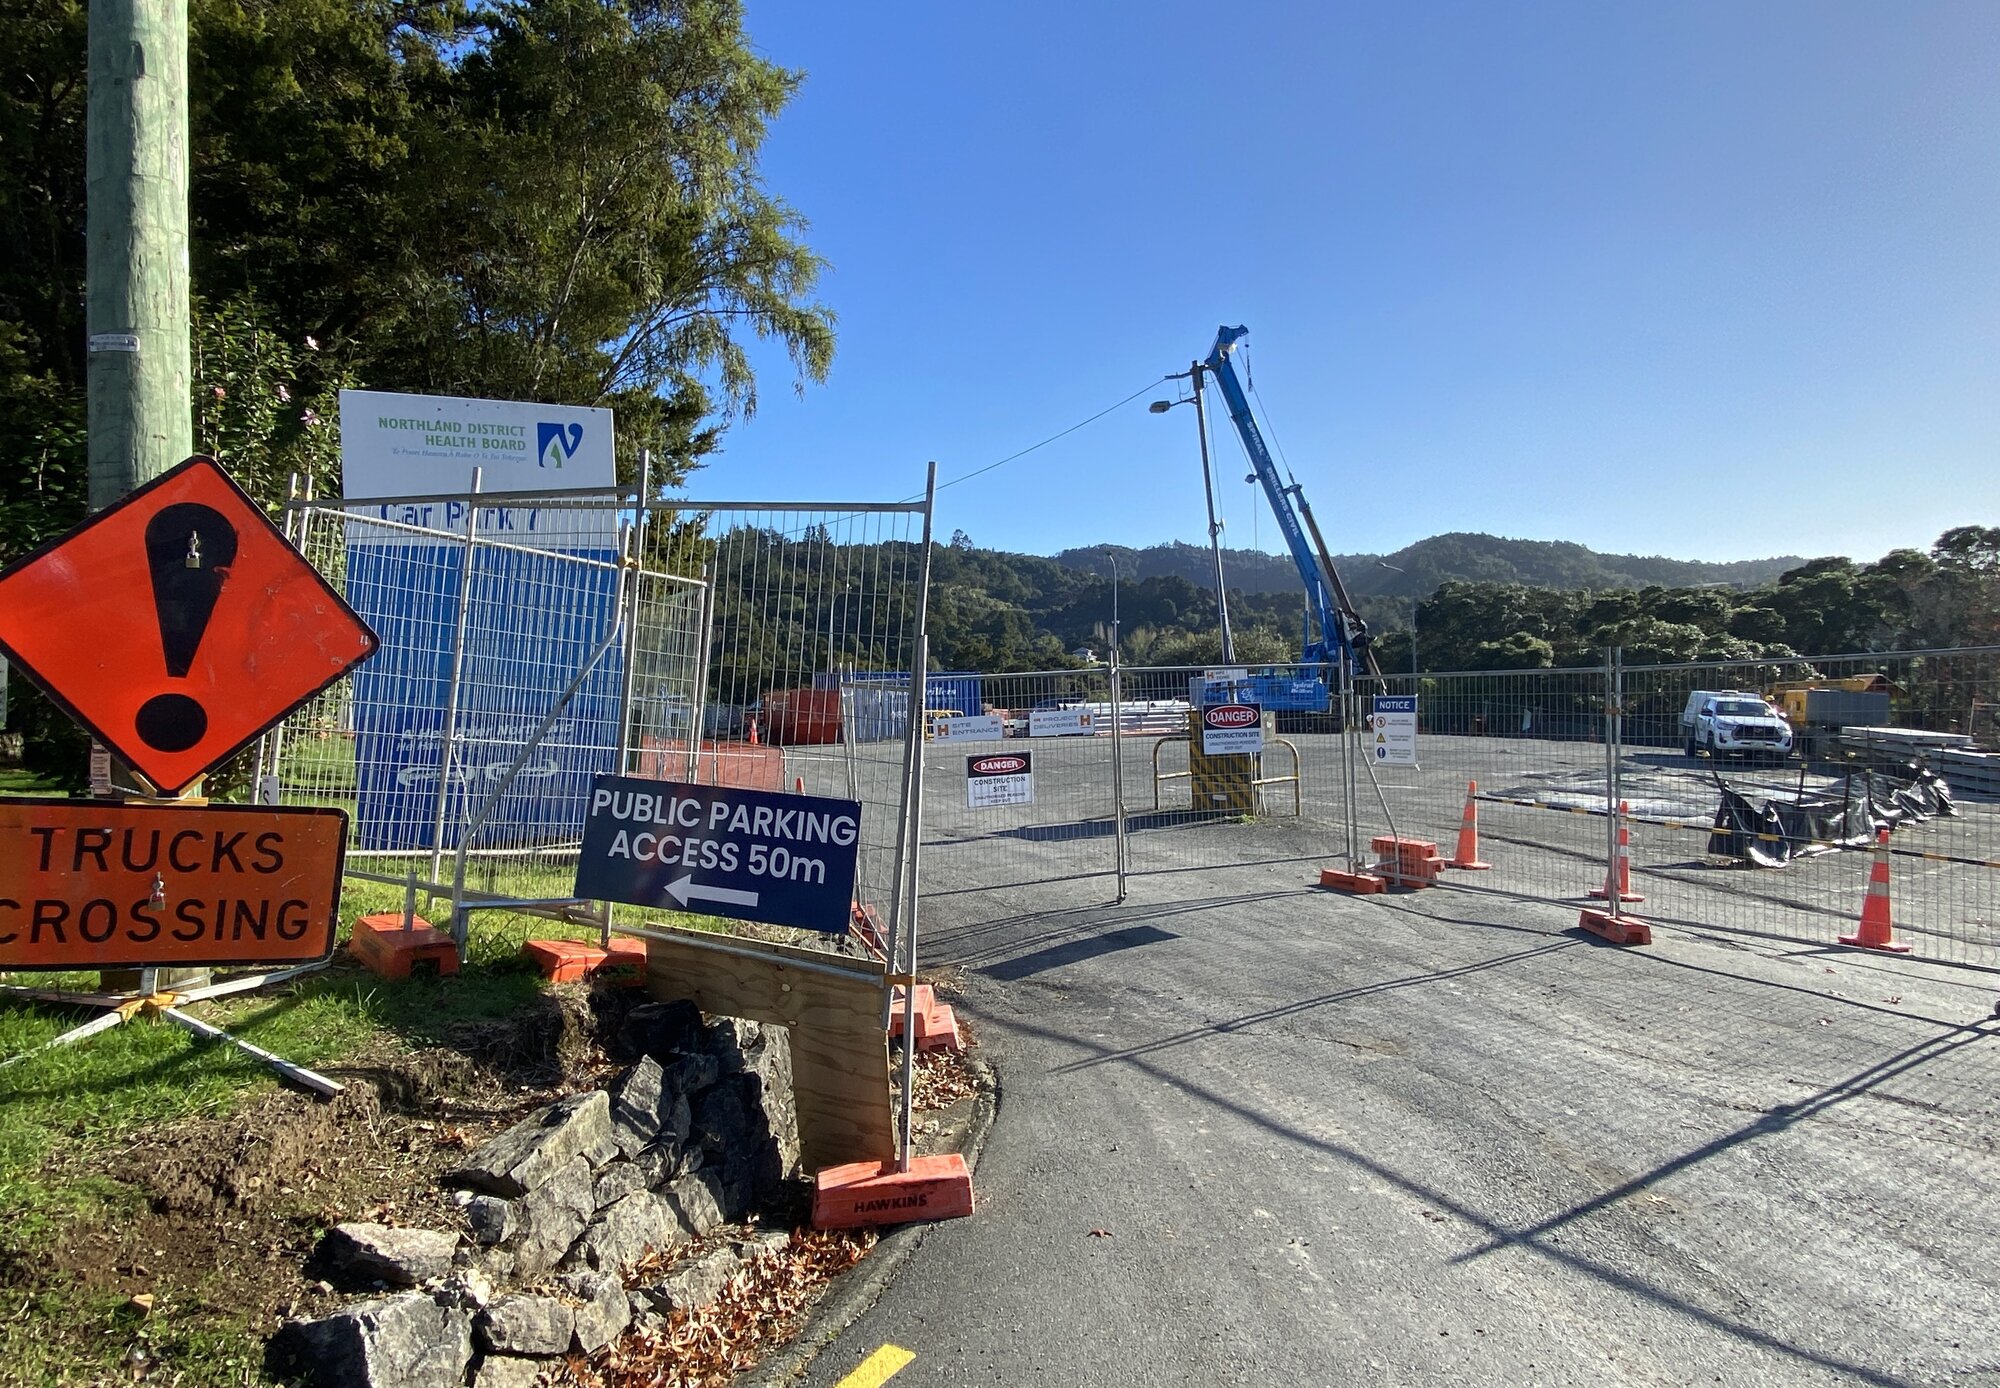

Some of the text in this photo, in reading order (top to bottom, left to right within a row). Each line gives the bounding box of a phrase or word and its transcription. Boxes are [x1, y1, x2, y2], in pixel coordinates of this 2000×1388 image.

[378, 417, 526, 437] NORTHLAND DISTRICT
[425, 435, 526, 451] HEALTH BOARD
[1246, 421, 1300, 538] SPIRAL DRILLERS CIVIL
[380, 502, 432, 527] Car
[1379, 701, 1410, 709] NOTICE
[1210, 710, 1254, 723] DANGER
[952, 727, 999, 736] ENTRANCE
[1033, 722, 1079, 730] DELIVERIES
[1205, 732, 1247, 740] CONSTRUCTION
[980, 760, 1018, 771] DANGER
[973, 776, 1026, 786] CONSTRUCTION
[591, 788, 857, 846] PUBLIC PARKING
[31, 826, 285, 873] TRUCKS
[607, 829, 825, 885] ACCESS 50m
[853, 1193, 928, 1213] HAWKINS
